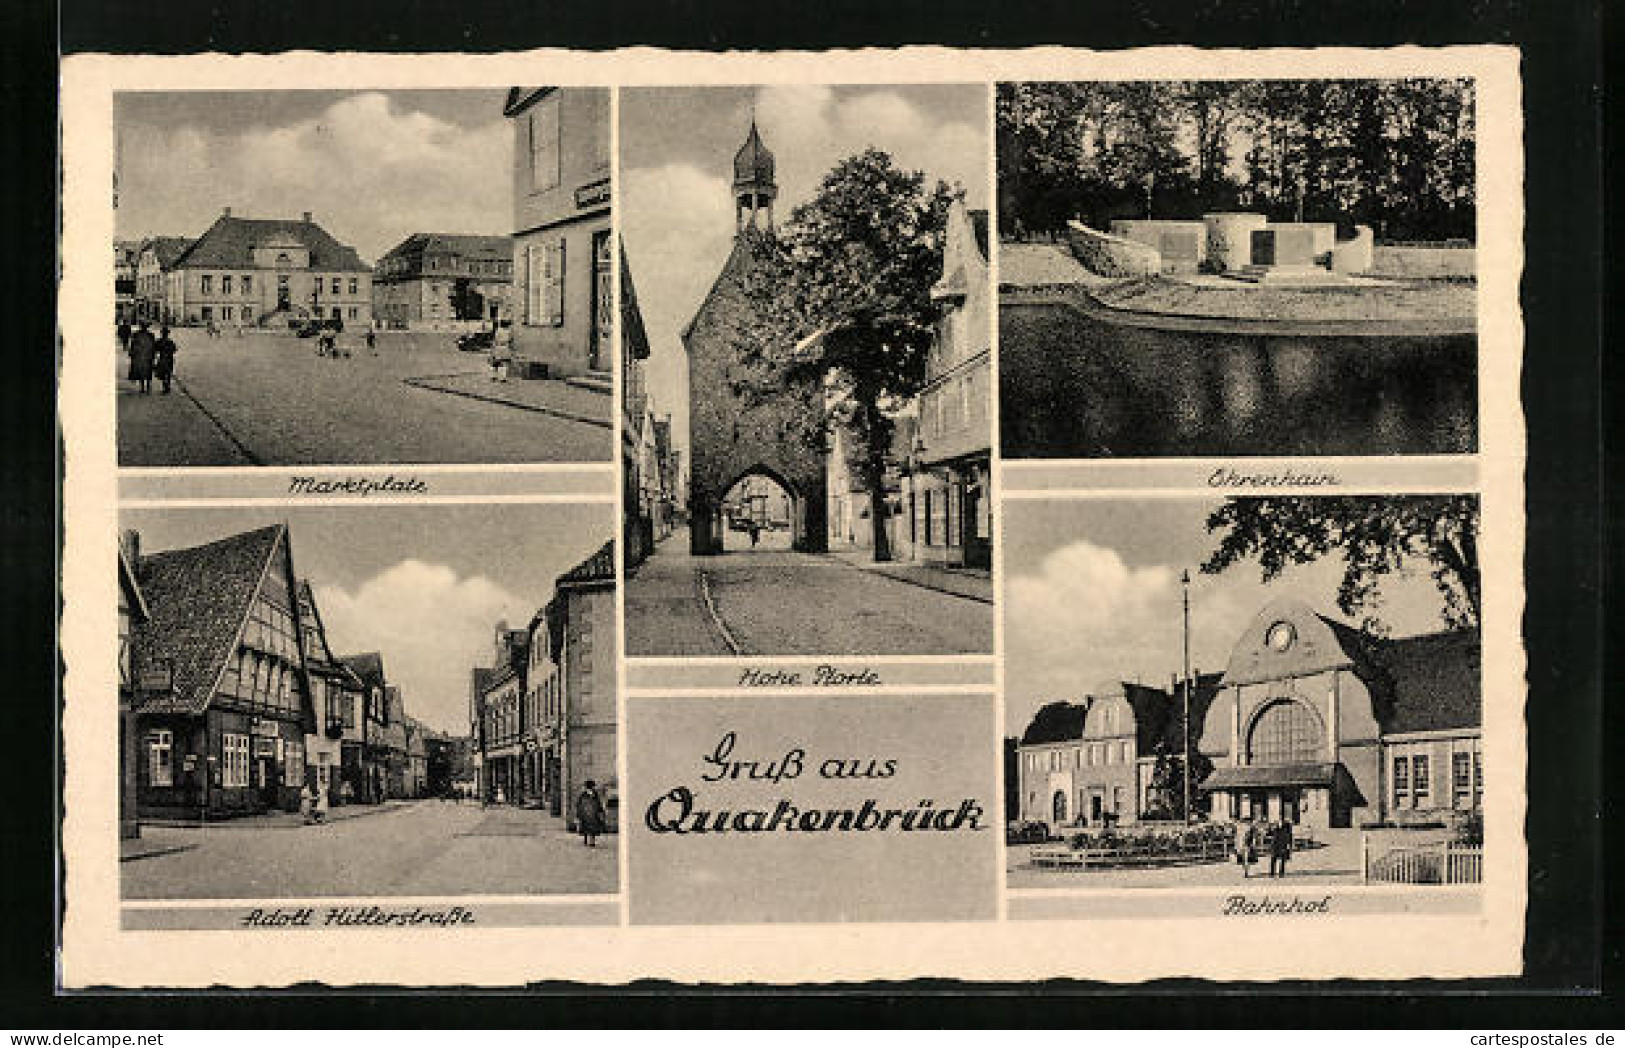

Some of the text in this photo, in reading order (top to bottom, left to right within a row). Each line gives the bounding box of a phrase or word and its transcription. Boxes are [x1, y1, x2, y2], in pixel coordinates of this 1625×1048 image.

[738, 667, 802, 687] Hohe
[702, 731, 897, 783] Gruß aus
[645, 786, 989, 834] Quakenbrück
[1223, 894, 1332, 916] Bahnhof
